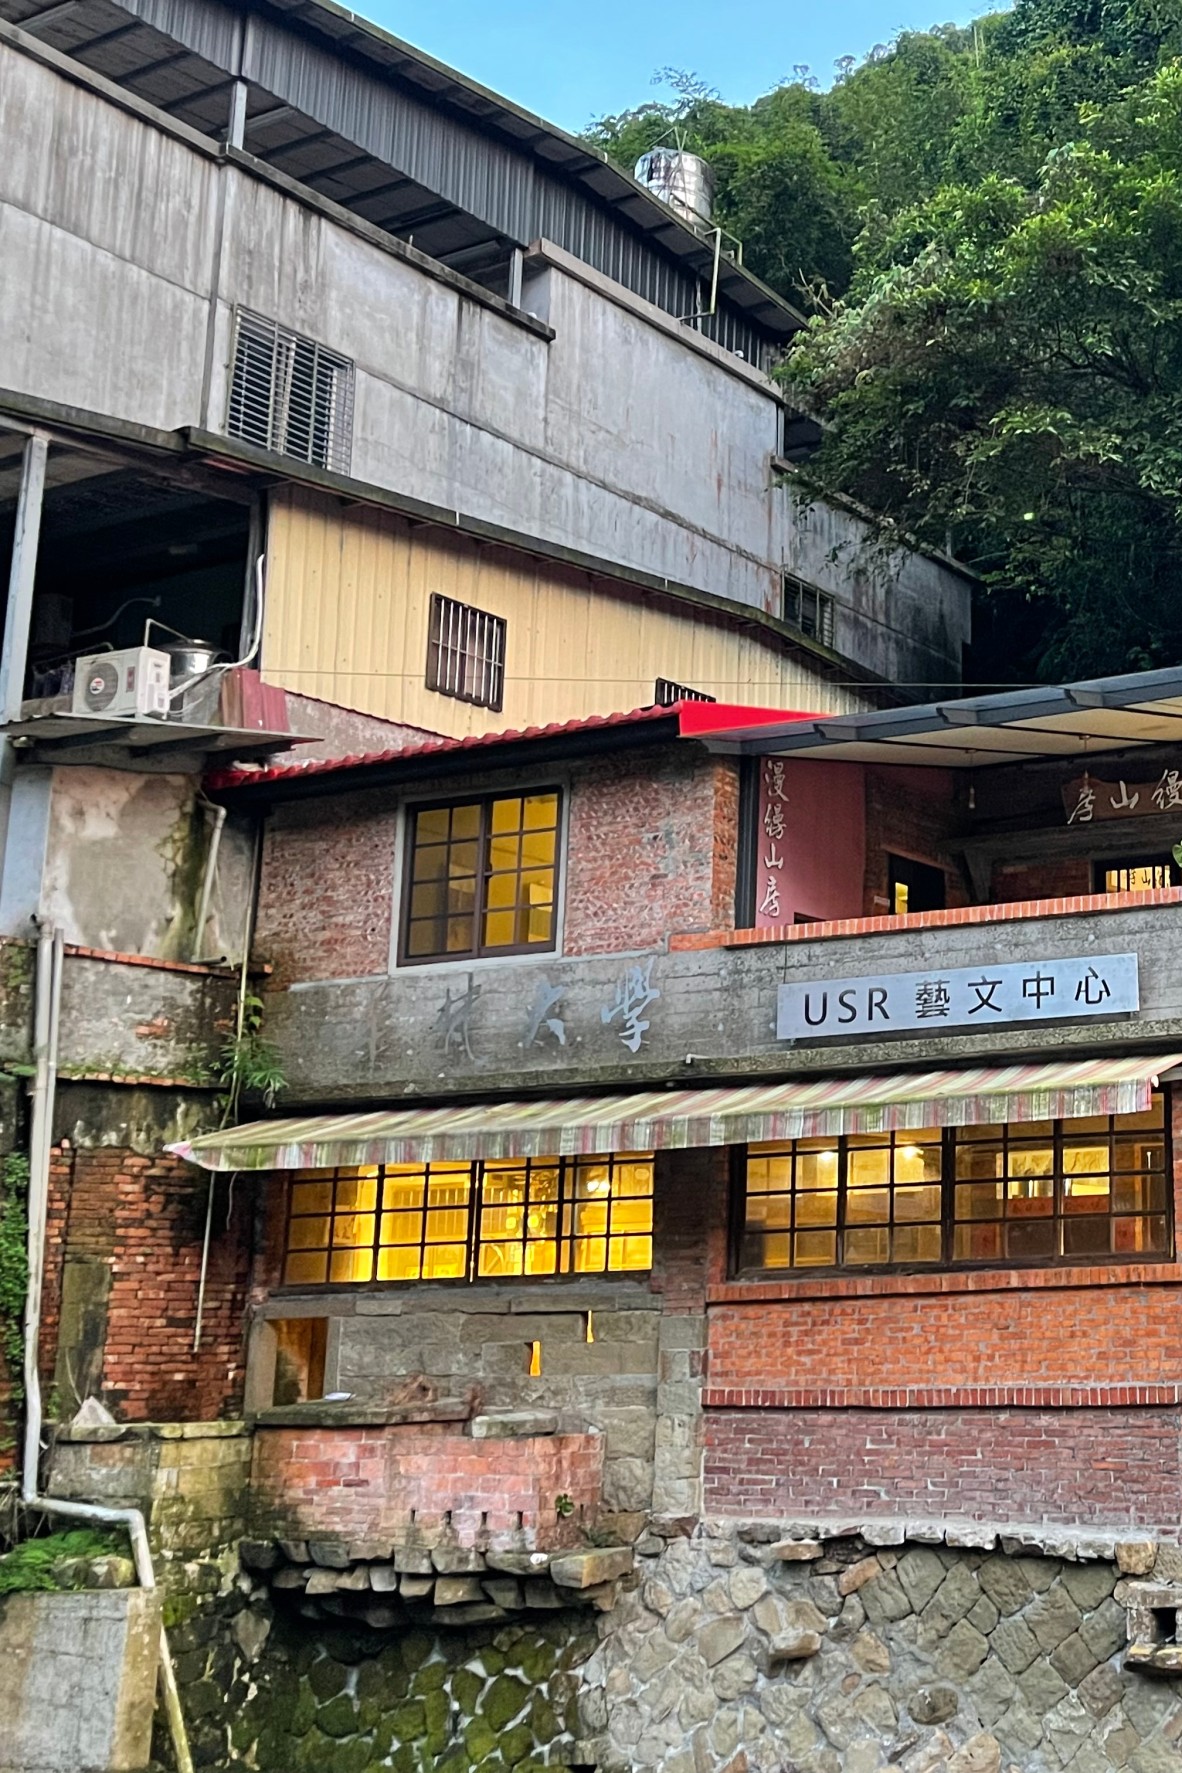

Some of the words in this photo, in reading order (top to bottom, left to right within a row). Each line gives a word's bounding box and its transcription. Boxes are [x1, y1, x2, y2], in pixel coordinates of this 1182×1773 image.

[804, 987, 890, 1026] USR
[915, 966, 1112, 1019] 藝文中心
